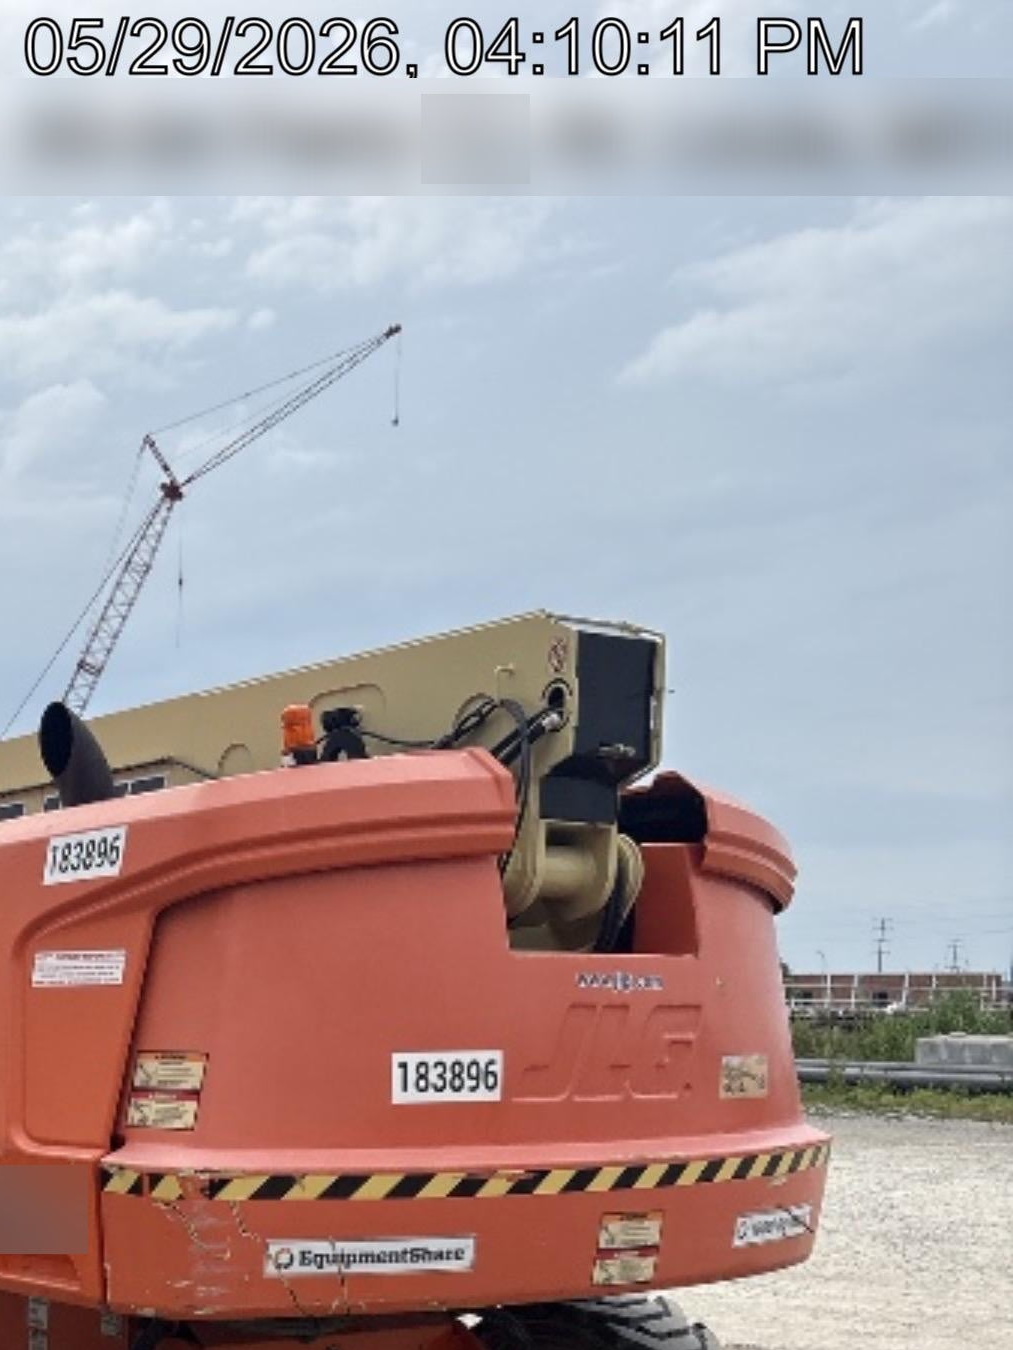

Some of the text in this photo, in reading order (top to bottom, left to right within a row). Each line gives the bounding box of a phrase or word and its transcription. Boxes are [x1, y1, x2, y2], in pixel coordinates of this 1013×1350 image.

[49, 833, 121, 876] 183896
[397, 1058, 499, 1093] 183896
[299, 1247, 466, 1269] EquipmentShare
